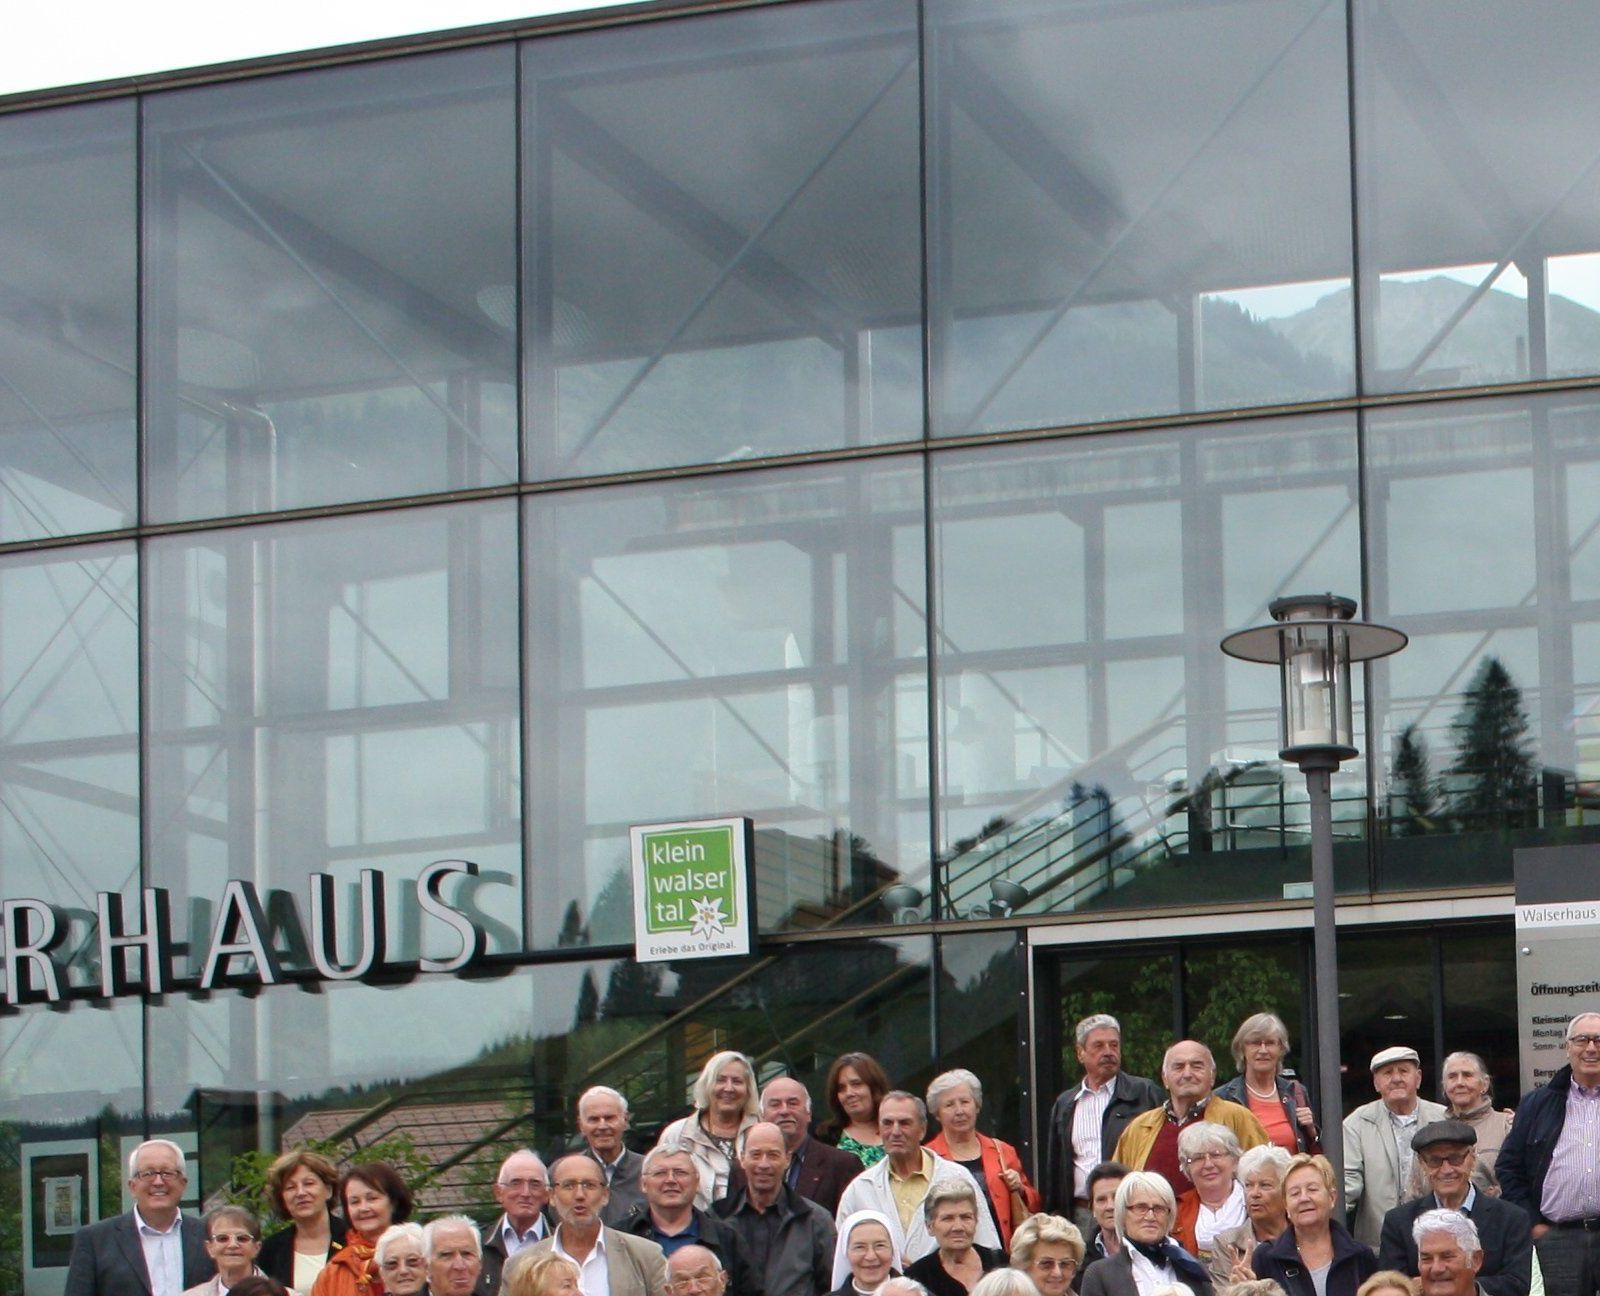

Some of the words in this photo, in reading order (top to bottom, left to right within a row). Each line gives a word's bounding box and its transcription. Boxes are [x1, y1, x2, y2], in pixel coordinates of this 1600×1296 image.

[652, 840, 705, 865] klein
[653, 868, 727, 893] walser
[655, 898, 683, 922] tal
[1522, 907, 1597, 922] Walserhaus
[3, 859, 484, 1003] RHAUS
[649, 945, 679, 955] Erlebe
[681, 944, 696, 953] das
